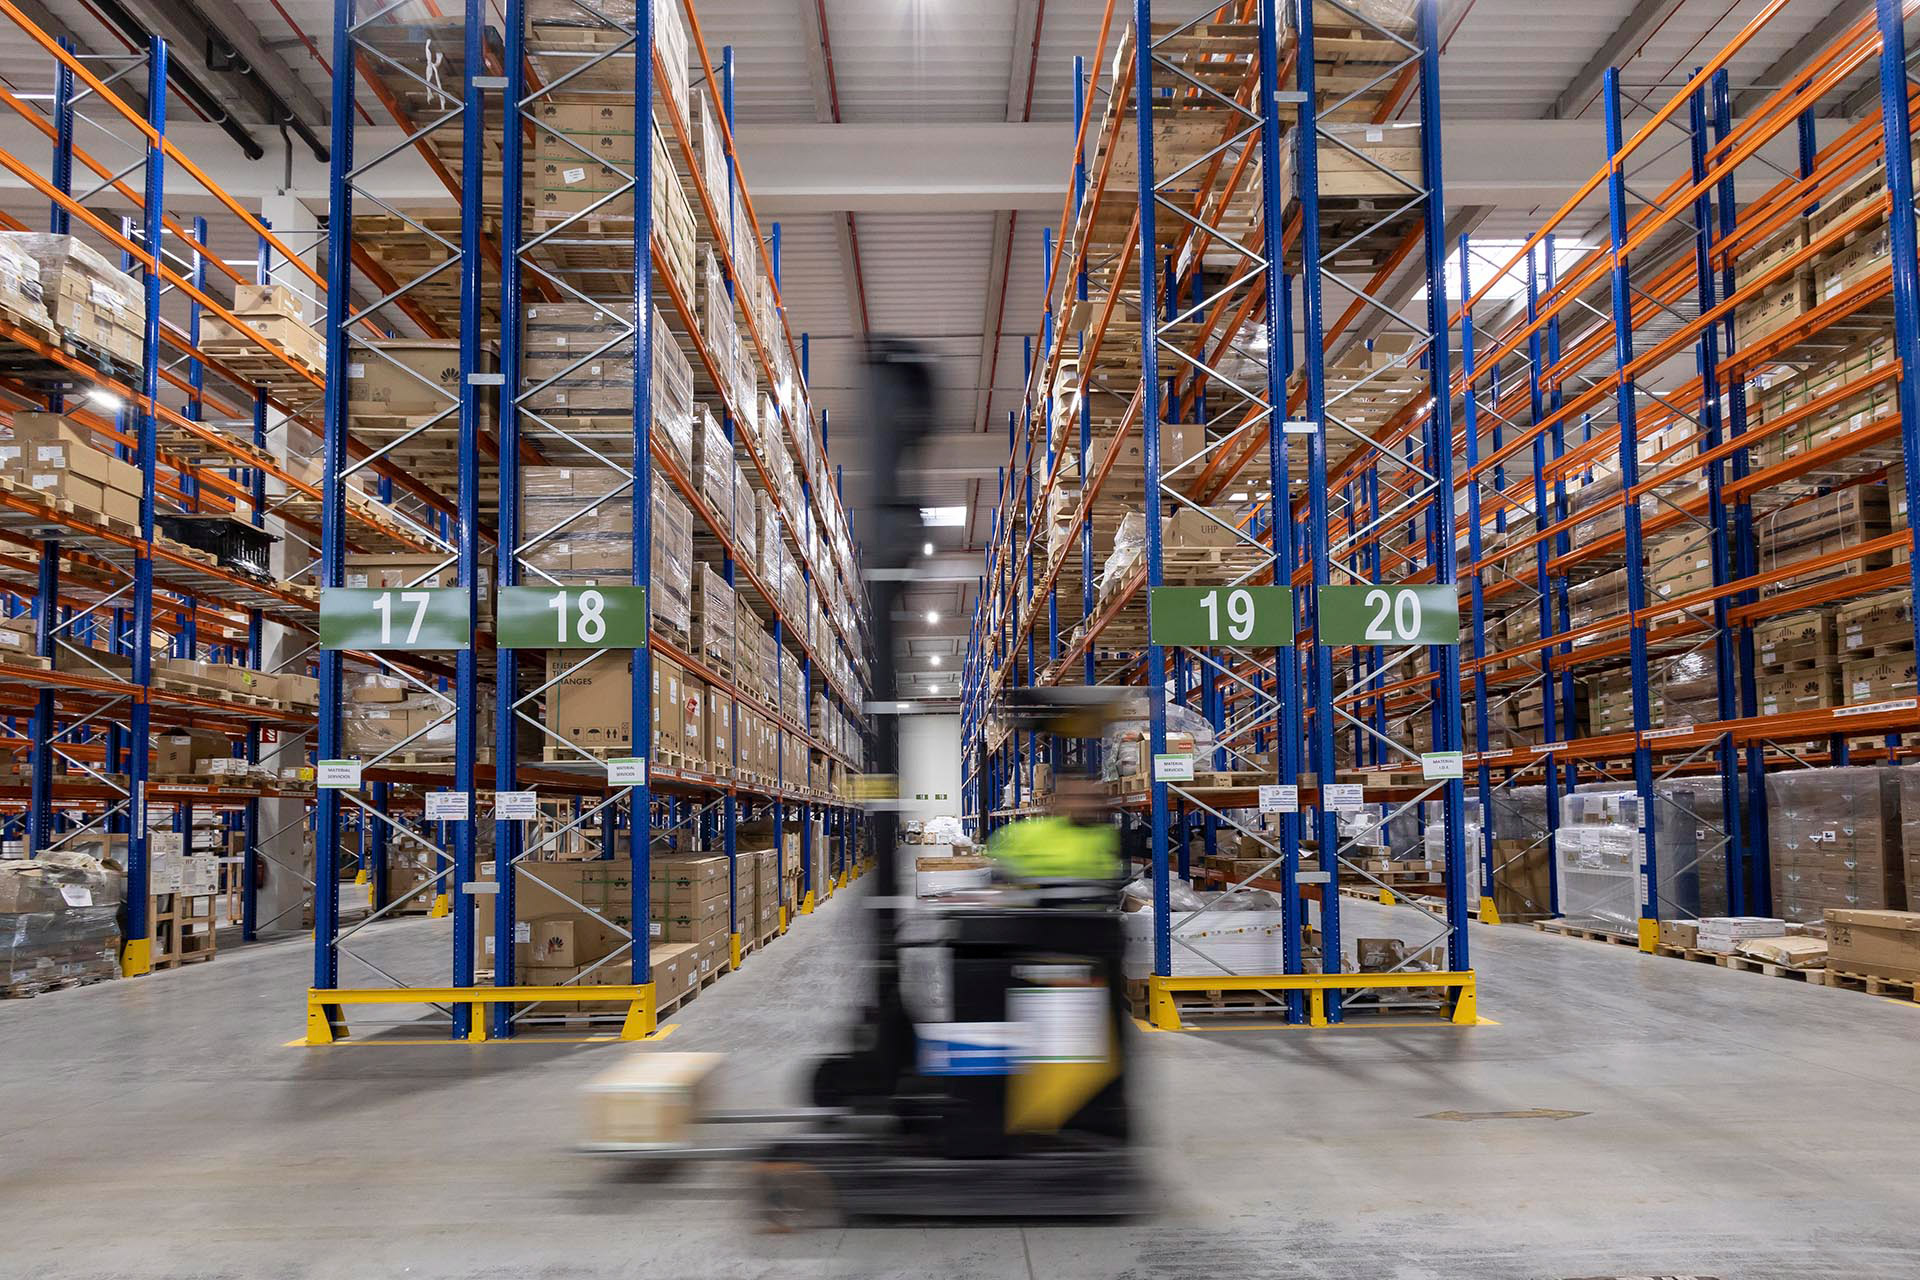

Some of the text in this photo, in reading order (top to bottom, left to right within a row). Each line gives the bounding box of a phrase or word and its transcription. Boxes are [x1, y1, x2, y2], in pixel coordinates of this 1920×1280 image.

[1200, 525, 1219, 534] UHP
[372, 591, 430, 644] 17
[548, 589, 607, 643] 18
[1199, 589, 1255, 641] 19
[1364, 589, 1422, 641] 20
